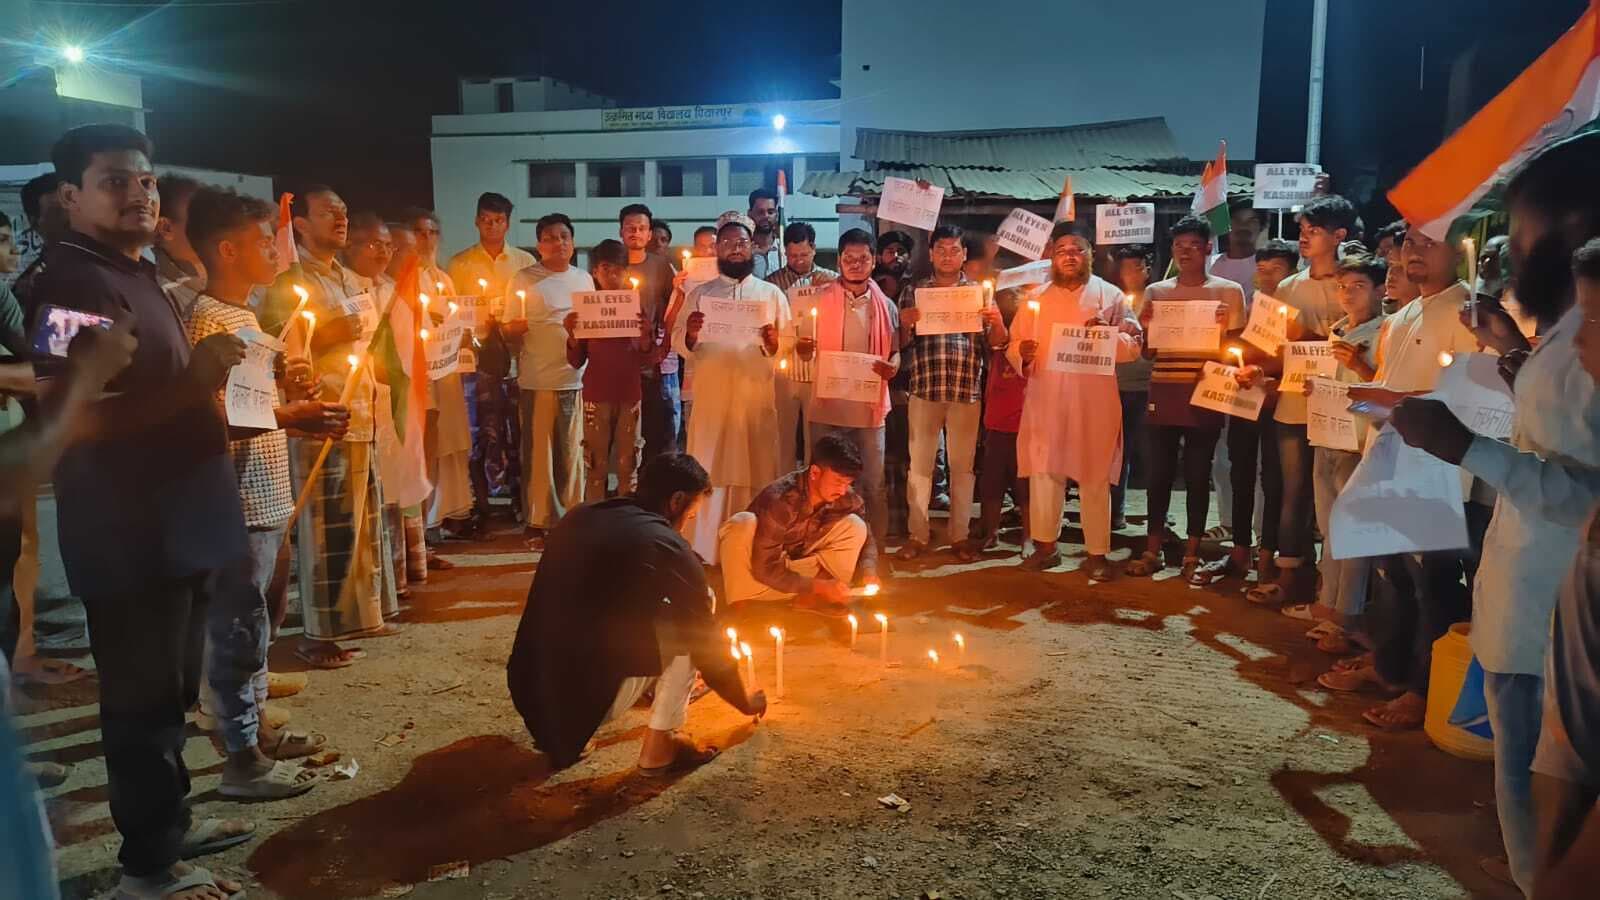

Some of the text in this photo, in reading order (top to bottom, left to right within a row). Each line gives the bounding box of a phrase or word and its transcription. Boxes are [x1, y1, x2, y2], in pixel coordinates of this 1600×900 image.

[635, 111, 653, 120] मध्य
[657, 106, 691, 120] विद्यालय
[1266, 167, 1315, 176] ALL EYES
[1282, 179, 1298, 188] ON
[1105, 206, 1147, 217] ALL EYES
[1011, 210, 1048, 231] ALL EYES
[1119, 218, 1133, 226] ON
[1016, 224, 1030, 236] ON
[1104, 227, 1151, 238] KASHMIR
[1000, 230, 1041, 254] KASHMIR
[583, 294, 633, 304] ALL EYES
[600, 307, 616, 317] ON
[582, 319, 638, 330] KASHMIR
[1062, 327, 1110, 339] ALL EYES
[1077, 341, 1093, 352] ON
[1291, 345, 1308, 355] ALL
[1056, 351, 1112, 366] KASHMIR
[1306, 359, 1318, 369] ON
